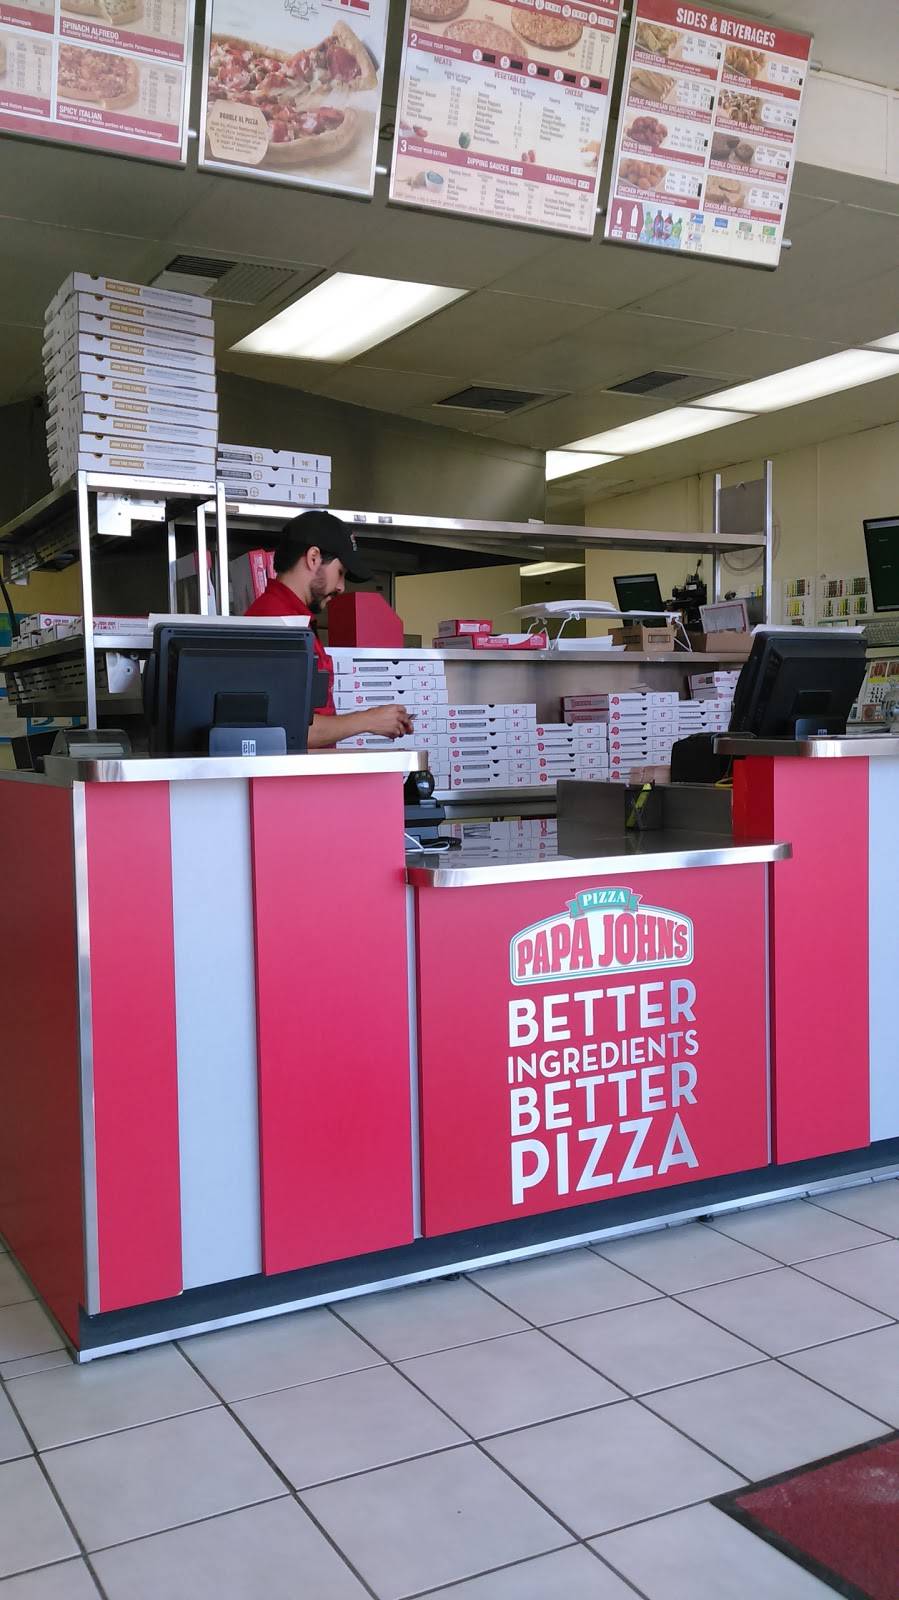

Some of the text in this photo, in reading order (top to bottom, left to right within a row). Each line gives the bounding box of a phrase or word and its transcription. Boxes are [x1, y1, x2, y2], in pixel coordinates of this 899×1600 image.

[62, 20, 119, 40] SPINACH ALFREDO
[676, 8, 707, 28] SIDES
[710, 17, 718, 33] &
[720, 20, 776, 47] BEVERAGES
[411, 33, 418, 47] 2
[495, 71, 527, 84] VEGETABLES
[60, 105, 78, 115] SPICY
[79, 110, 103, 121] ITALIAN
[400, 139, 407, 153] 3
[467, 157, 489, 168] DIPPING
[489, 162, 510, 173] SAUCES
[546, 173, 577, 186] SEASONINGS
[582, 890, 626, 907] PIZZA
[517, 912, 689, 977] PAPA JOHN'S
[508, 978, 697, 1048] BETTER
[507, 1029, 700, 1084] INGREDIENTS
[510, 1061, 698, 1137] BETTER
[511, 1112, 700, 1206] PIZZA
